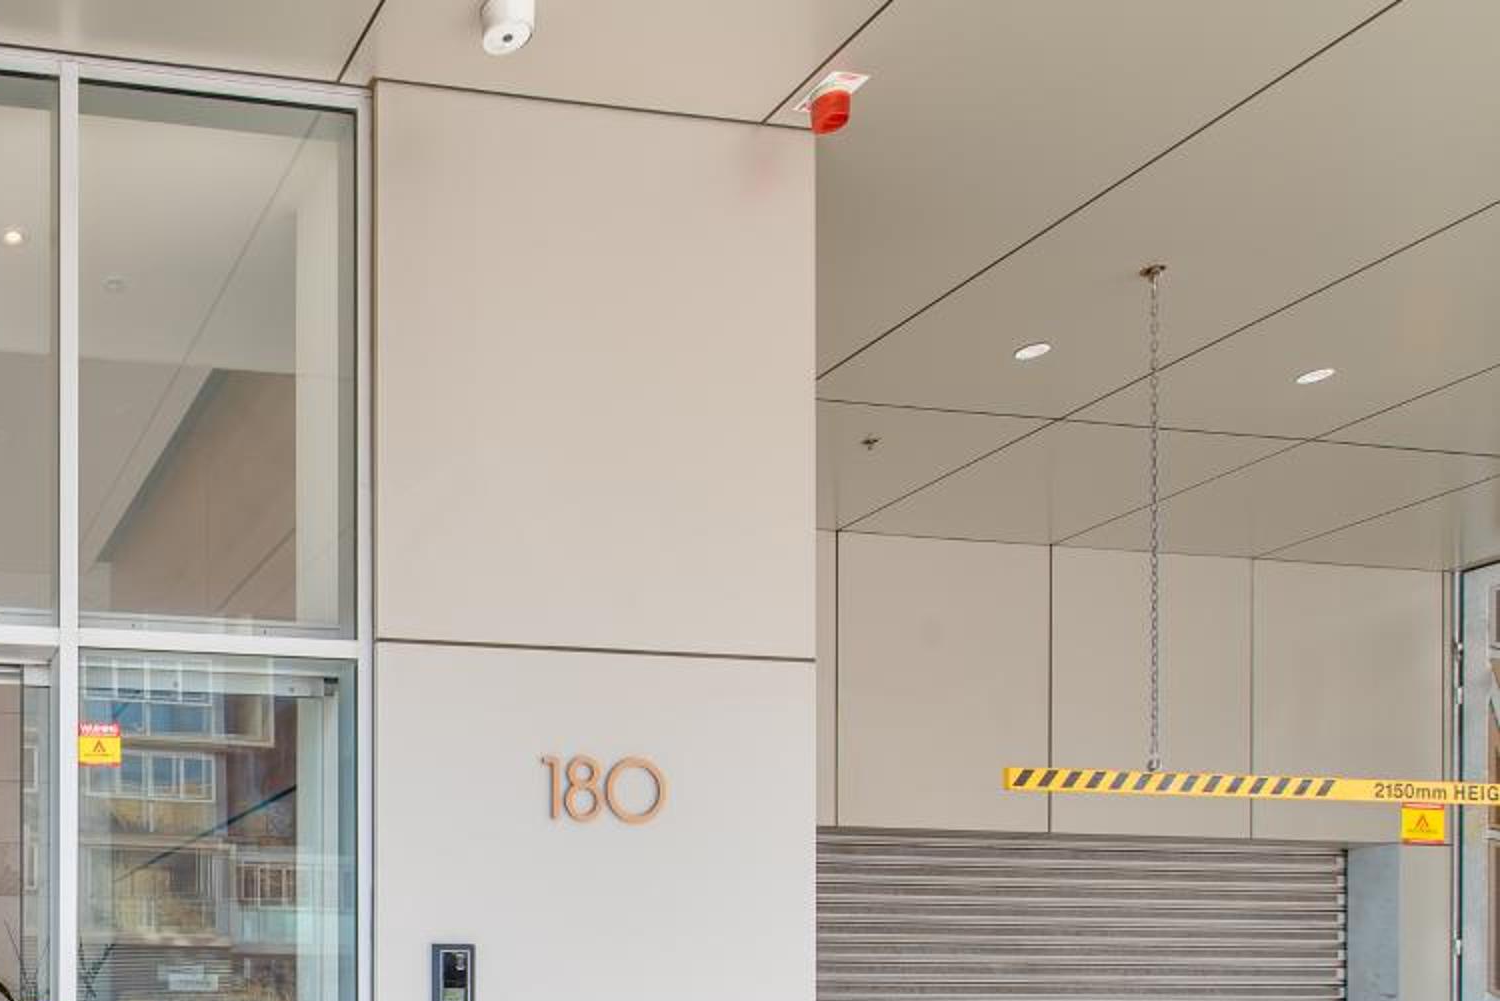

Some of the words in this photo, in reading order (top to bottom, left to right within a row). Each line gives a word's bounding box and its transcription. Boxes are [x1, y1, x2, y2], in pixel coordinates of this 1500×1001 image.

[540, 755, 668, 826] 180
[1373, 782, 1447, 801] 2150mm
[1453, 784, 1500, 802] HEIG
